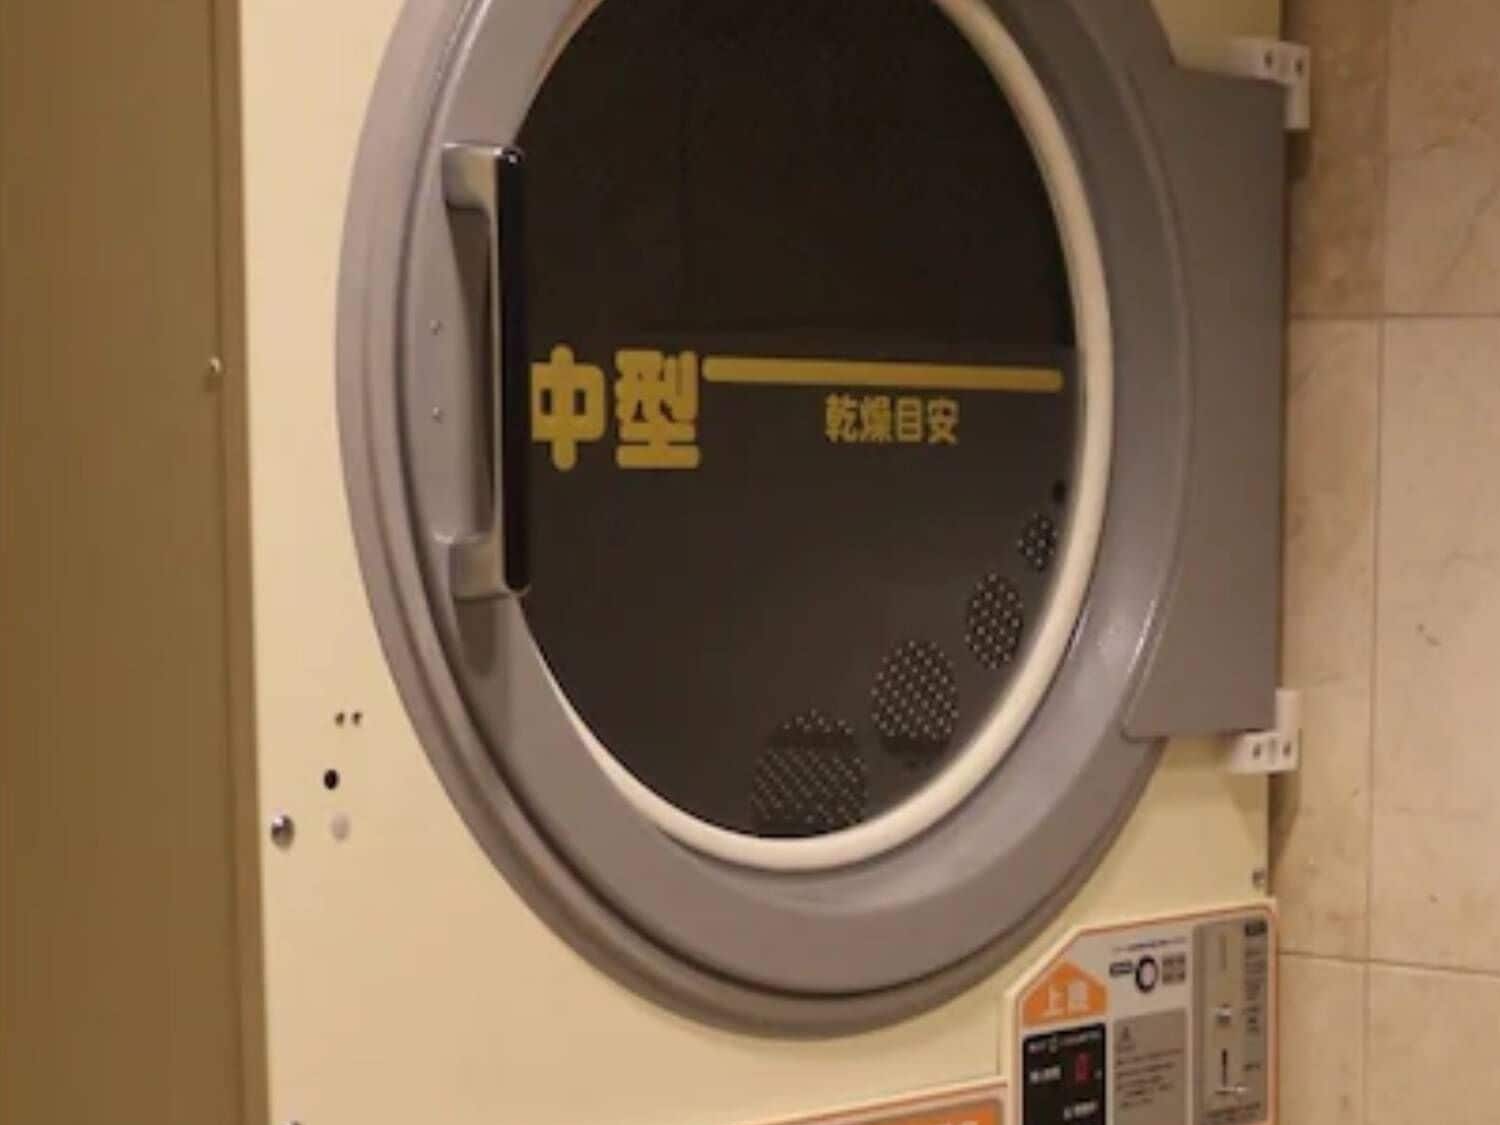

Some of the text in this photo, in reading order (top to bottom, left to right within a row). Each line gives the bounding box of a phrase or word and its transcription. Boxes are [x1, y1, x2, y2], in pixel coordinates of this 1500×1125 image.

[531, 344, 700, 470] 中型
[824, 394, 959, 444] 乾燥目安
